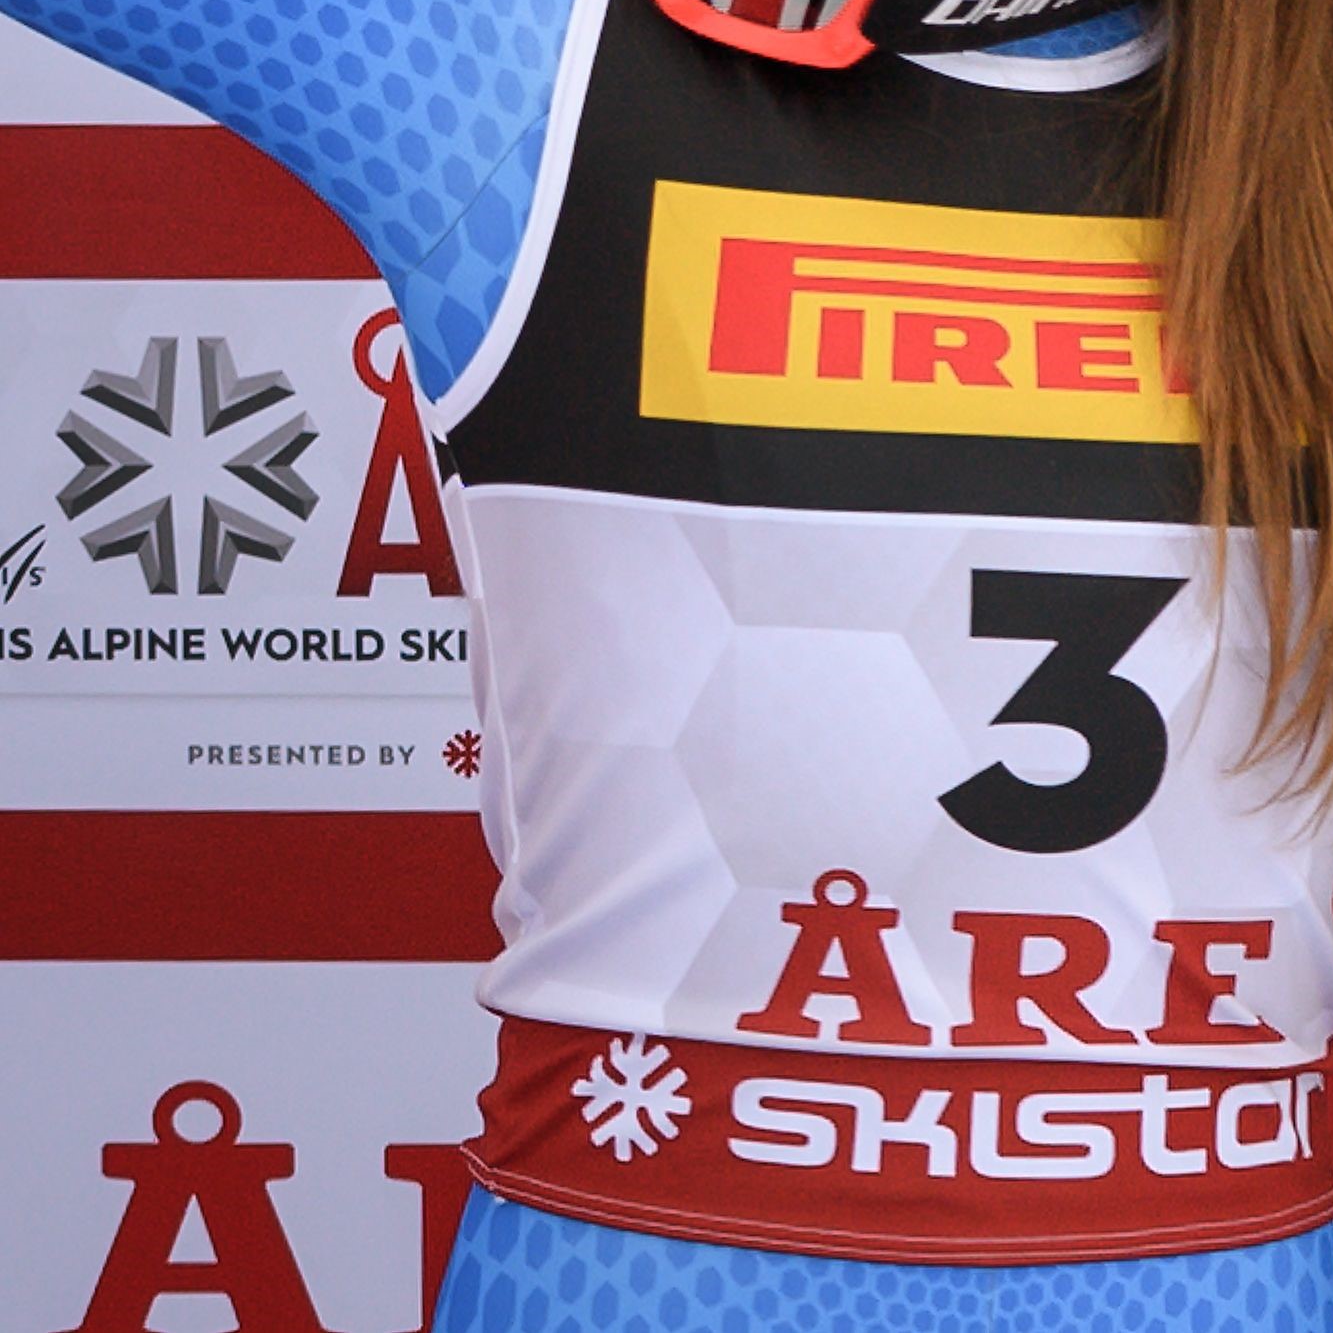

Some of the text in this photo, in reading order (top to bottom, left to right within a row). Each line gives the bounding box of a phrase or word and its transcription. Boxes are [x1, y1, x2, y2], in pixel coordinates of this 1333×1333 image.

[47, 627, 207, 662] ALPINE
[221, 627, 385, 662] WORLD
[399, 627, 468, 662] SKI
[937, 567, 1191, 854] 3
[188, 745, 416, 766] PRESENTED BY
[737, 869, 1284, 1048] ÅRE
[50, 1080, 478, 1333] Å
